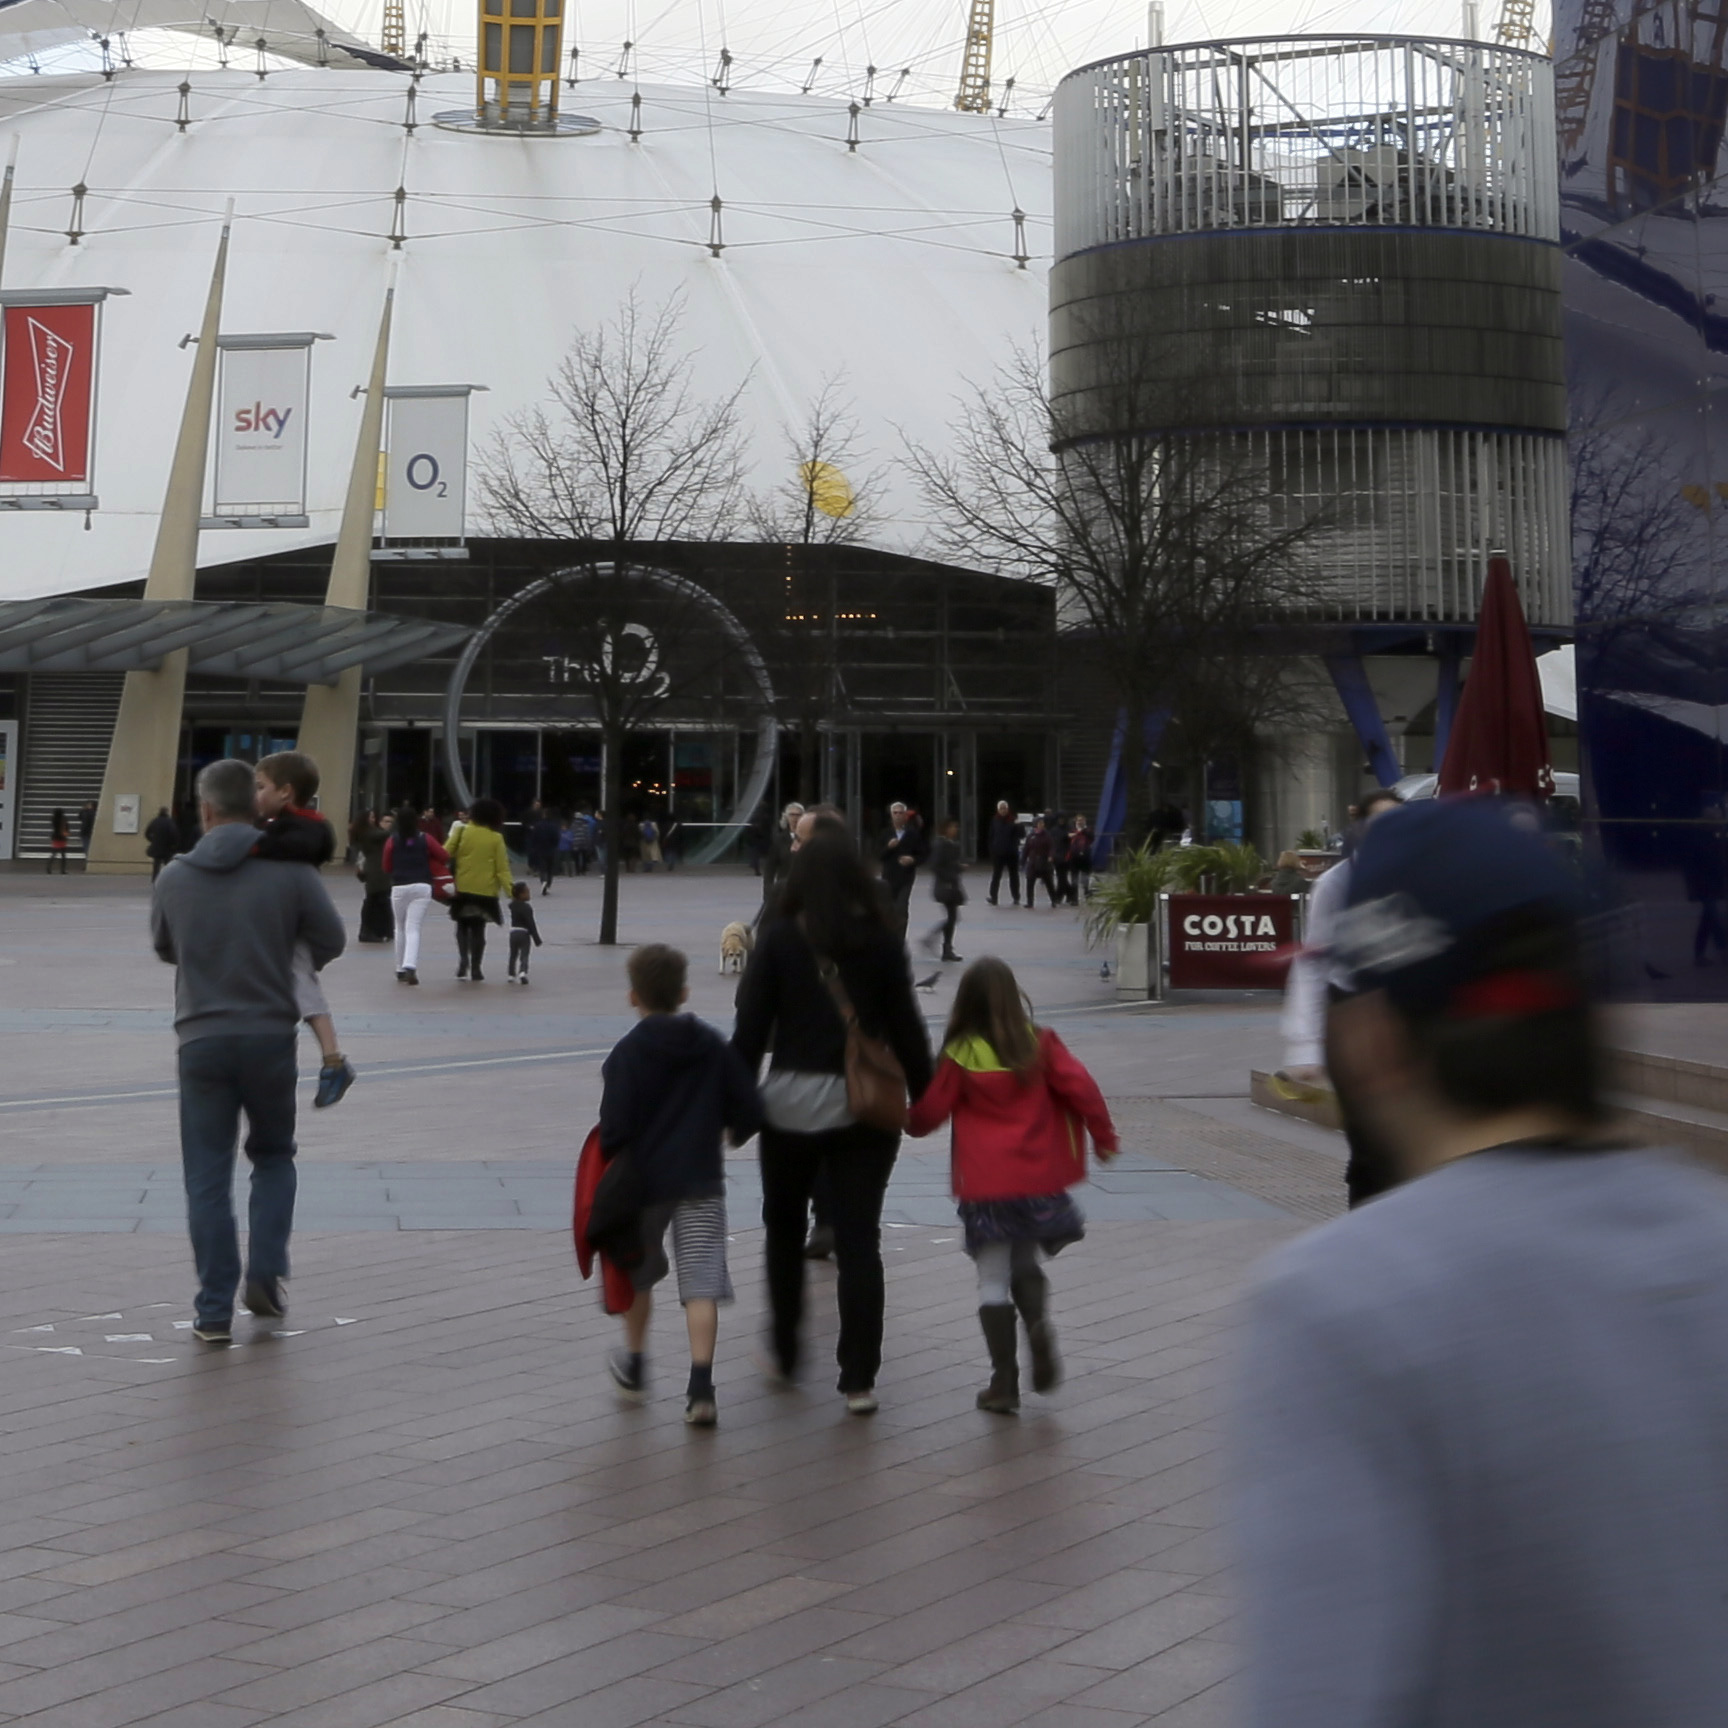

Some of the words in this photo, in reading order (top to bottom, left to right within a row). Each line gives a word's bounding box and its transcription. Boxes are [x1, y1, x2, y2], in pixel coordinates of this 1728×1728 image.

[32, 334, 59, 459] Budweiser
[234, 401, 292, 439] sky
[406, 453, 448, 498] O2
[1183, 914, 1277, 939] COSTA
[1184, 941, 1204, 952] FOR
[1204, 941, 1240, 952] COFFEE
[1240, 941, 1277, 952] LOVERS
